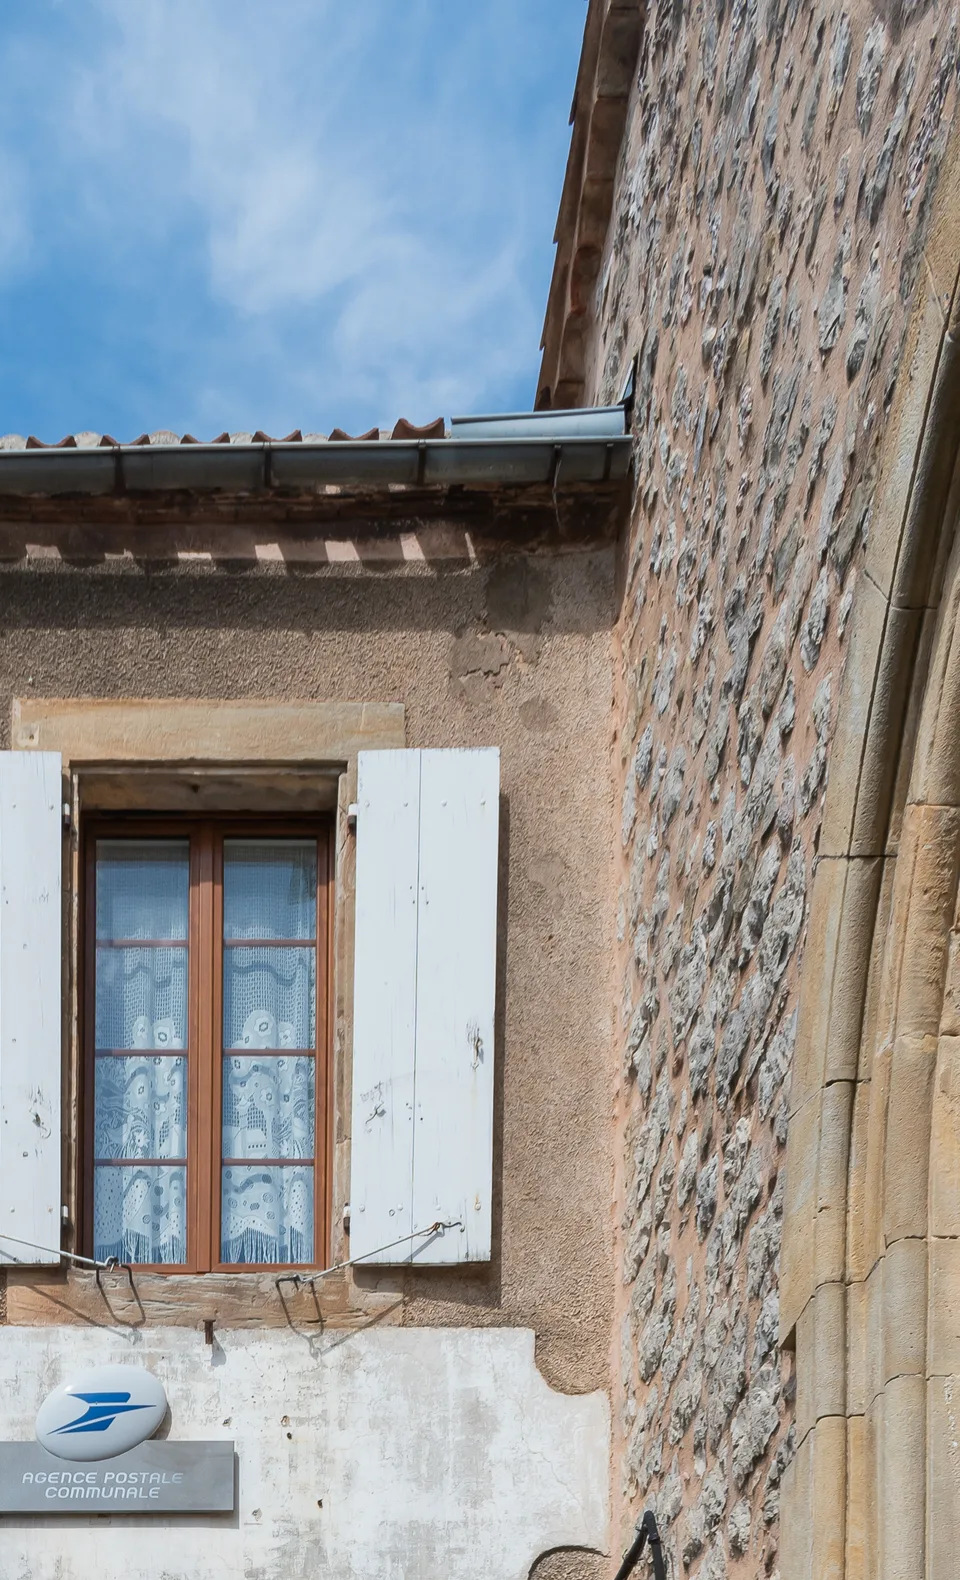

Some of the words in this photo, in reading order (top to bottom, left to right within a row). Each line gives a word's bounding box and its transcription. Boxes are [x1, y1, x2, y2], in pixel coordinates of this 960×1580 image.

[22, 1472, 98, 1484] AGENCE
[103, 1472, 184, 1484] POSTALE
[44, 1486, 161, 1499] COMMUNALE
